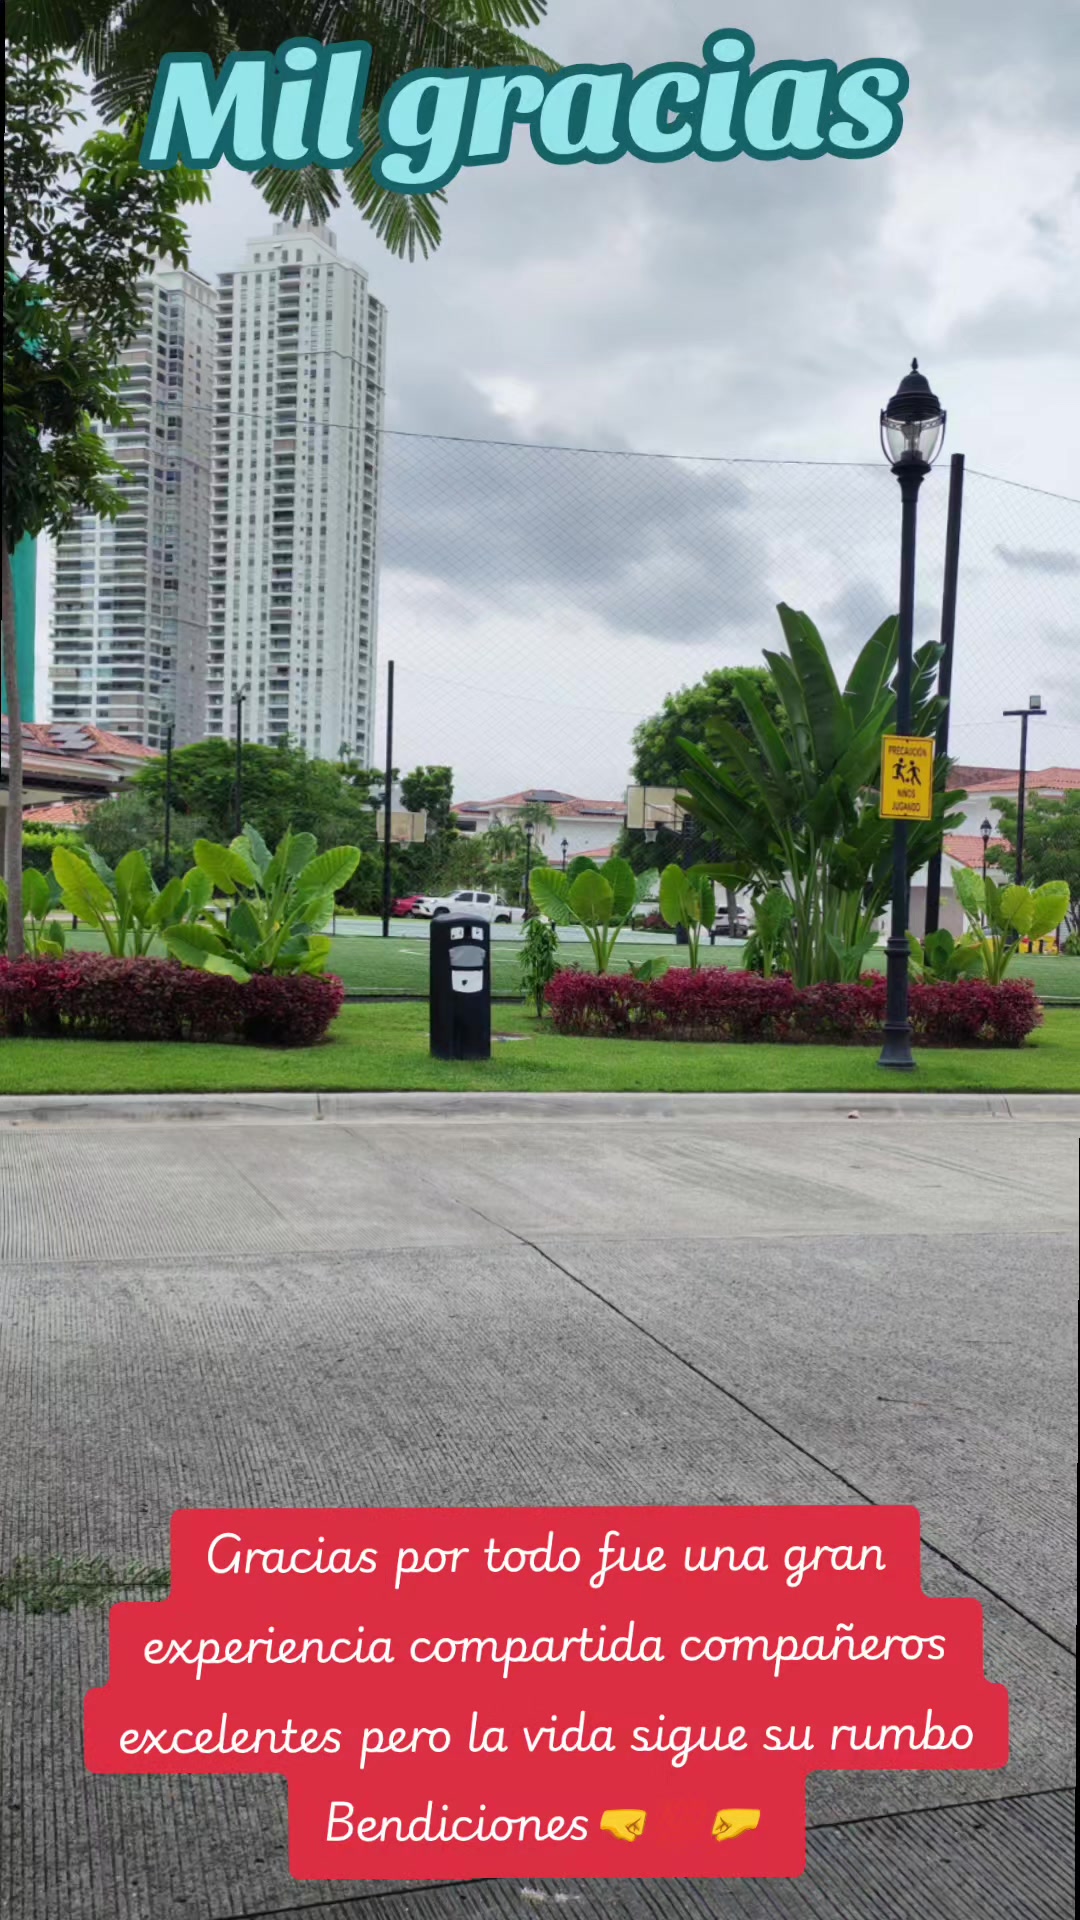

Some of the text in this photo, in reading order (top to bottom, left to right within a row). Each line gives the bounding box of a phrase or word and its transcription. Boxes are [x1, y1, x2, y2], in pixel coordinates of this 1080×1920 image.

[888, 745, 927, 757] PRECAUCIÓN
[897, 788, 915, 798] NIÑOS
[892, 802, 920, 812] JUGANDO
